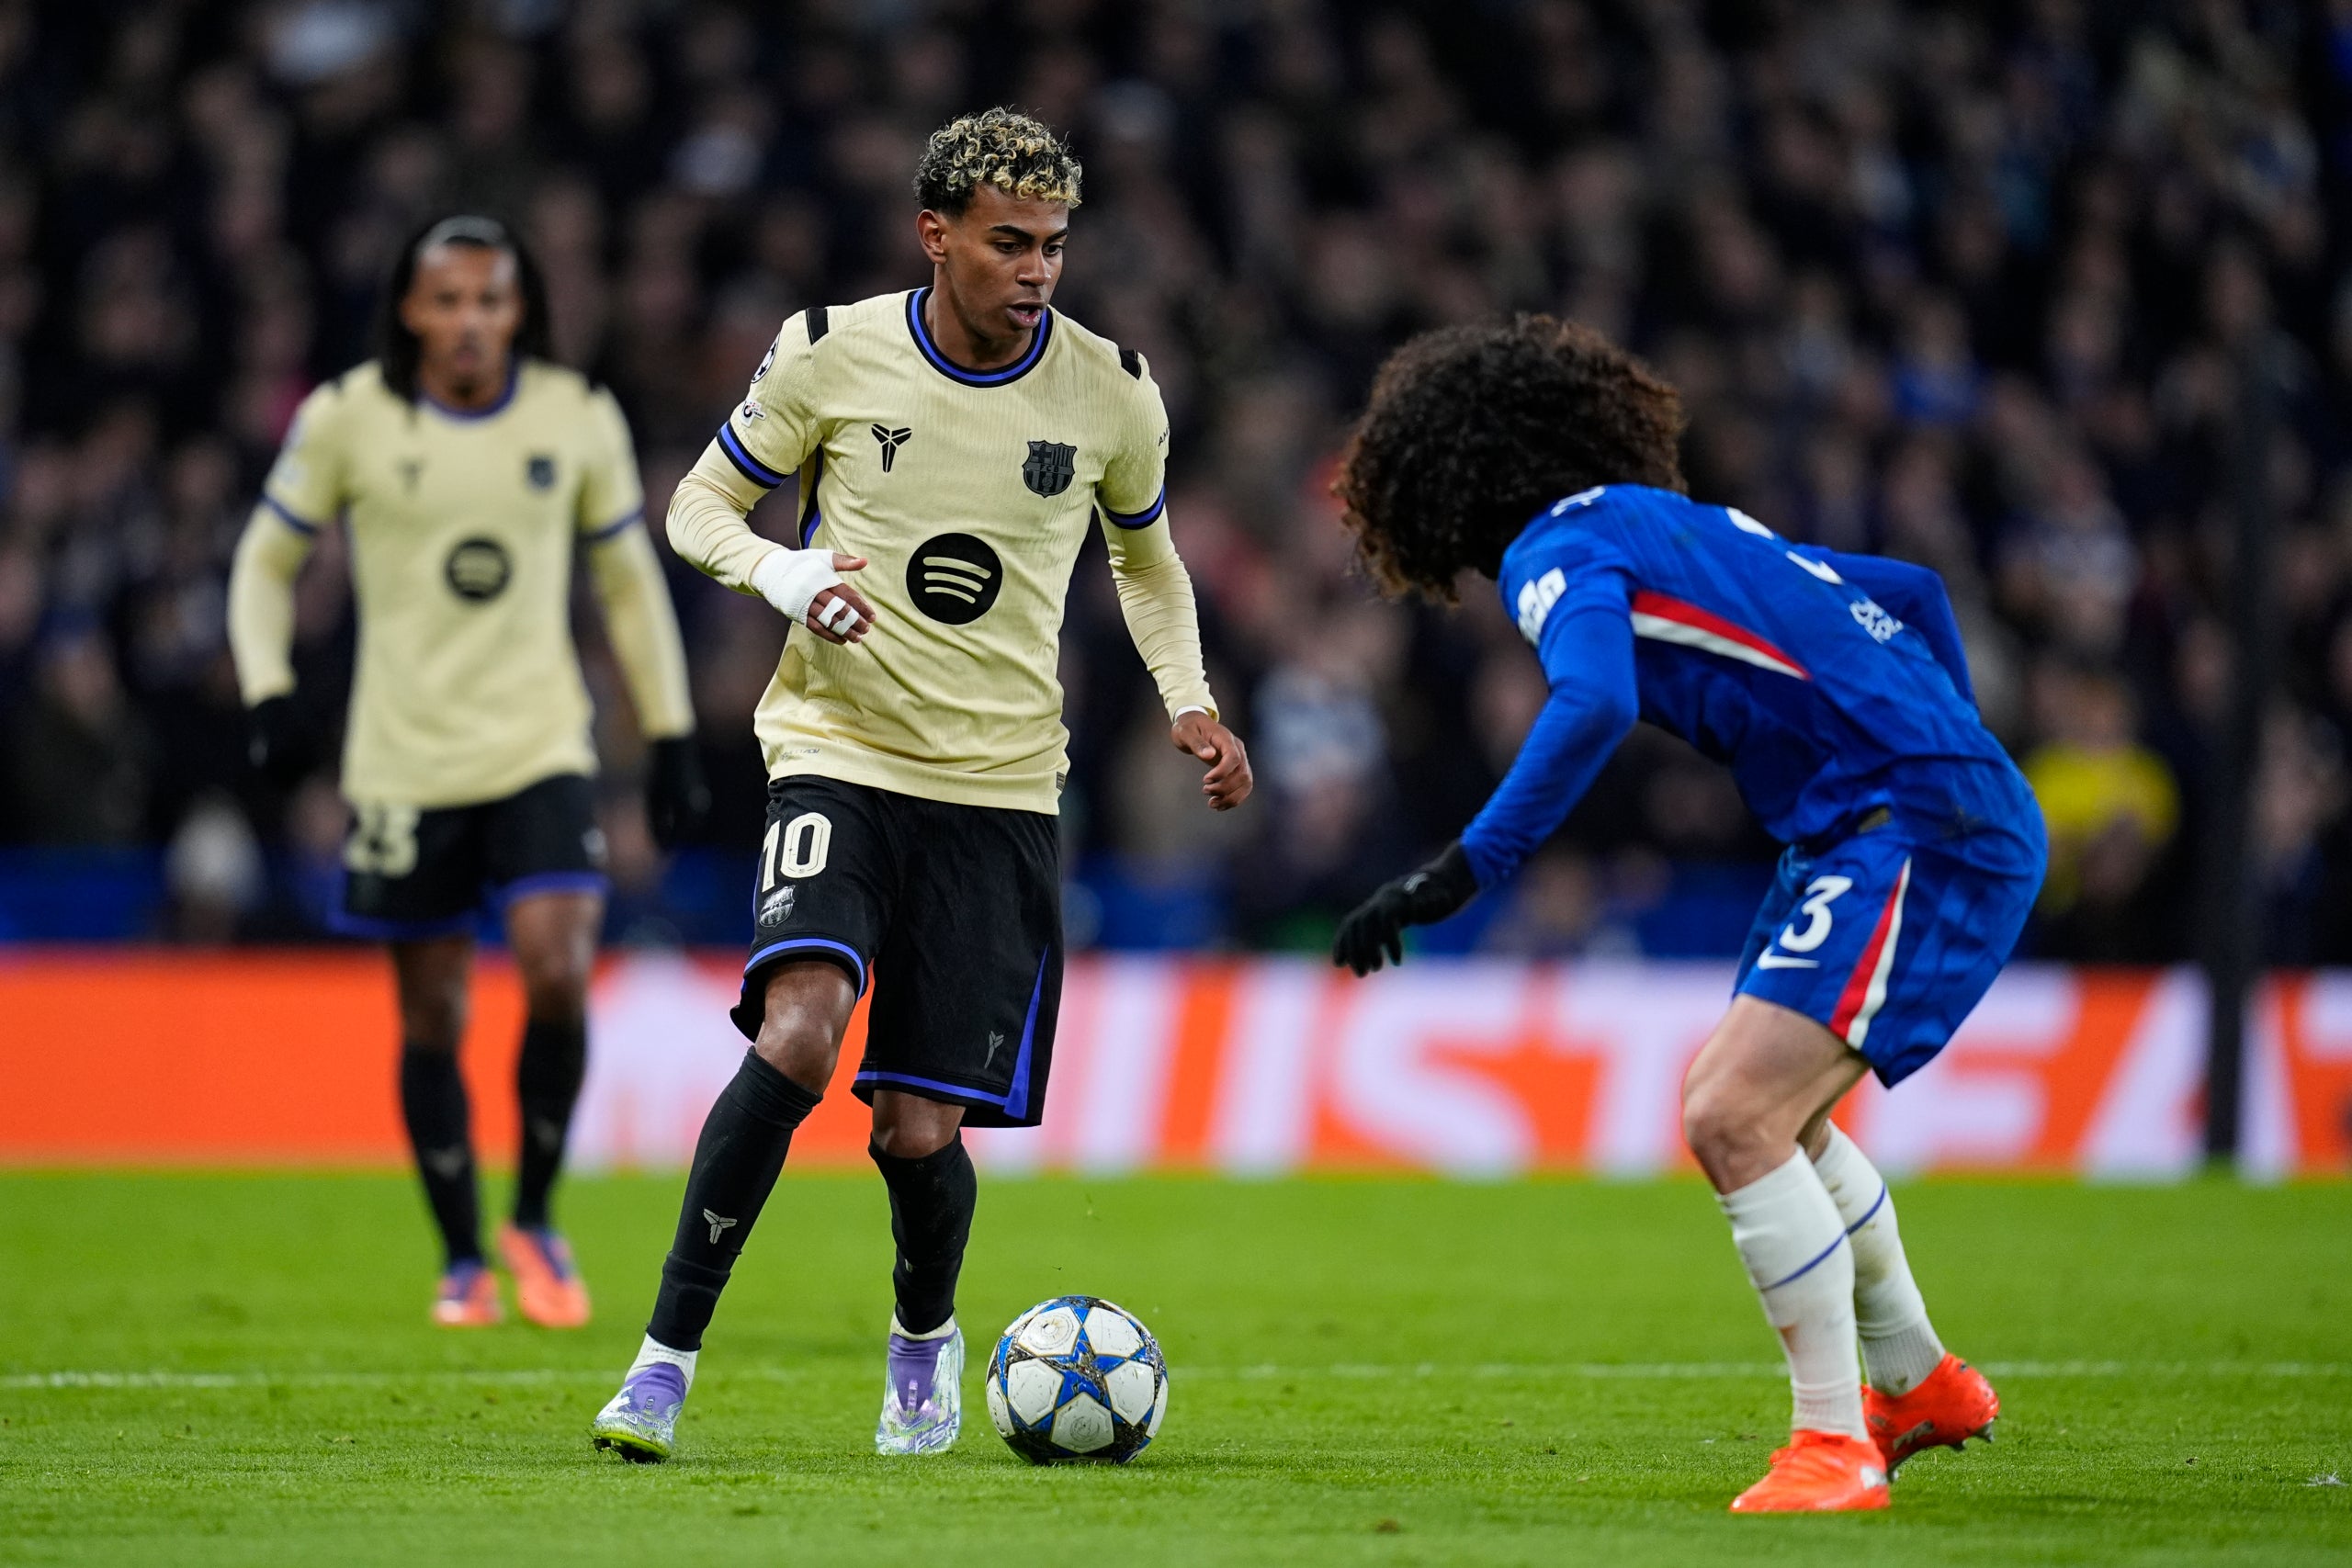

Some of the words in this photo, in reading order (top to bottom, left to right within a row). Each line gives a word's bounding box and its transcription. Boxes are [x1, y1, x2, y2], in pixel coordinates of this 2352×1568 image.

[1039, 463, 1060, 473] FCB
[762, 812, 832, 893] 10
[1779, 874, 1854, 953] 3
